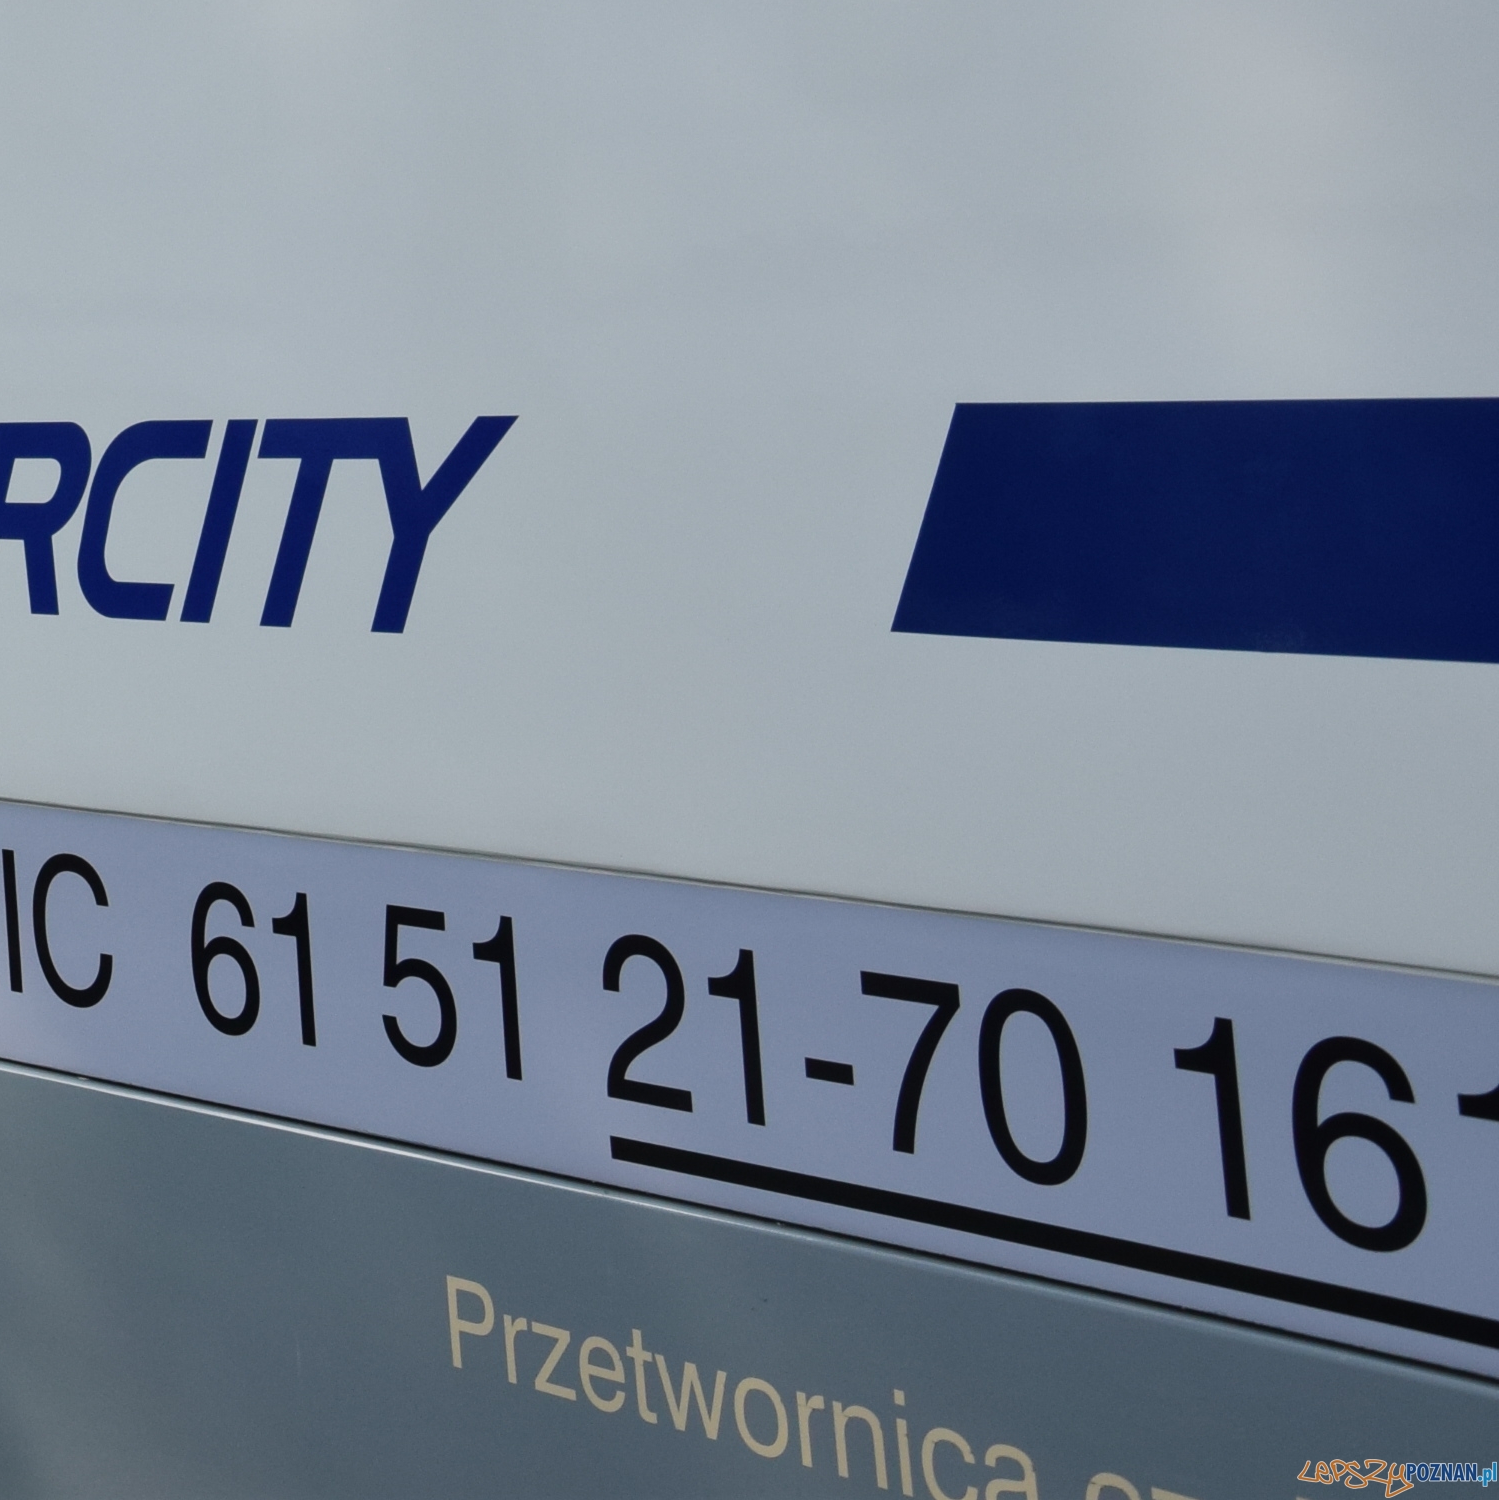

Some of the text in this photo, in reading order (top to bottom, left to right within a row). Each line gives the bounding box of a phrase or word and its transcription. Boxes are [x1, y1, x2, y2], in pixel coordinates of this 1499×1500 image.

[190, 881, 317, 1047] 61
[381, 904, 523, 1081] 51
[602, 934, 1088, 1186] 21-70
[1173, 1016, 1499, 1253] 16
[446, 1276, 1038, 1500] Przetwornica
